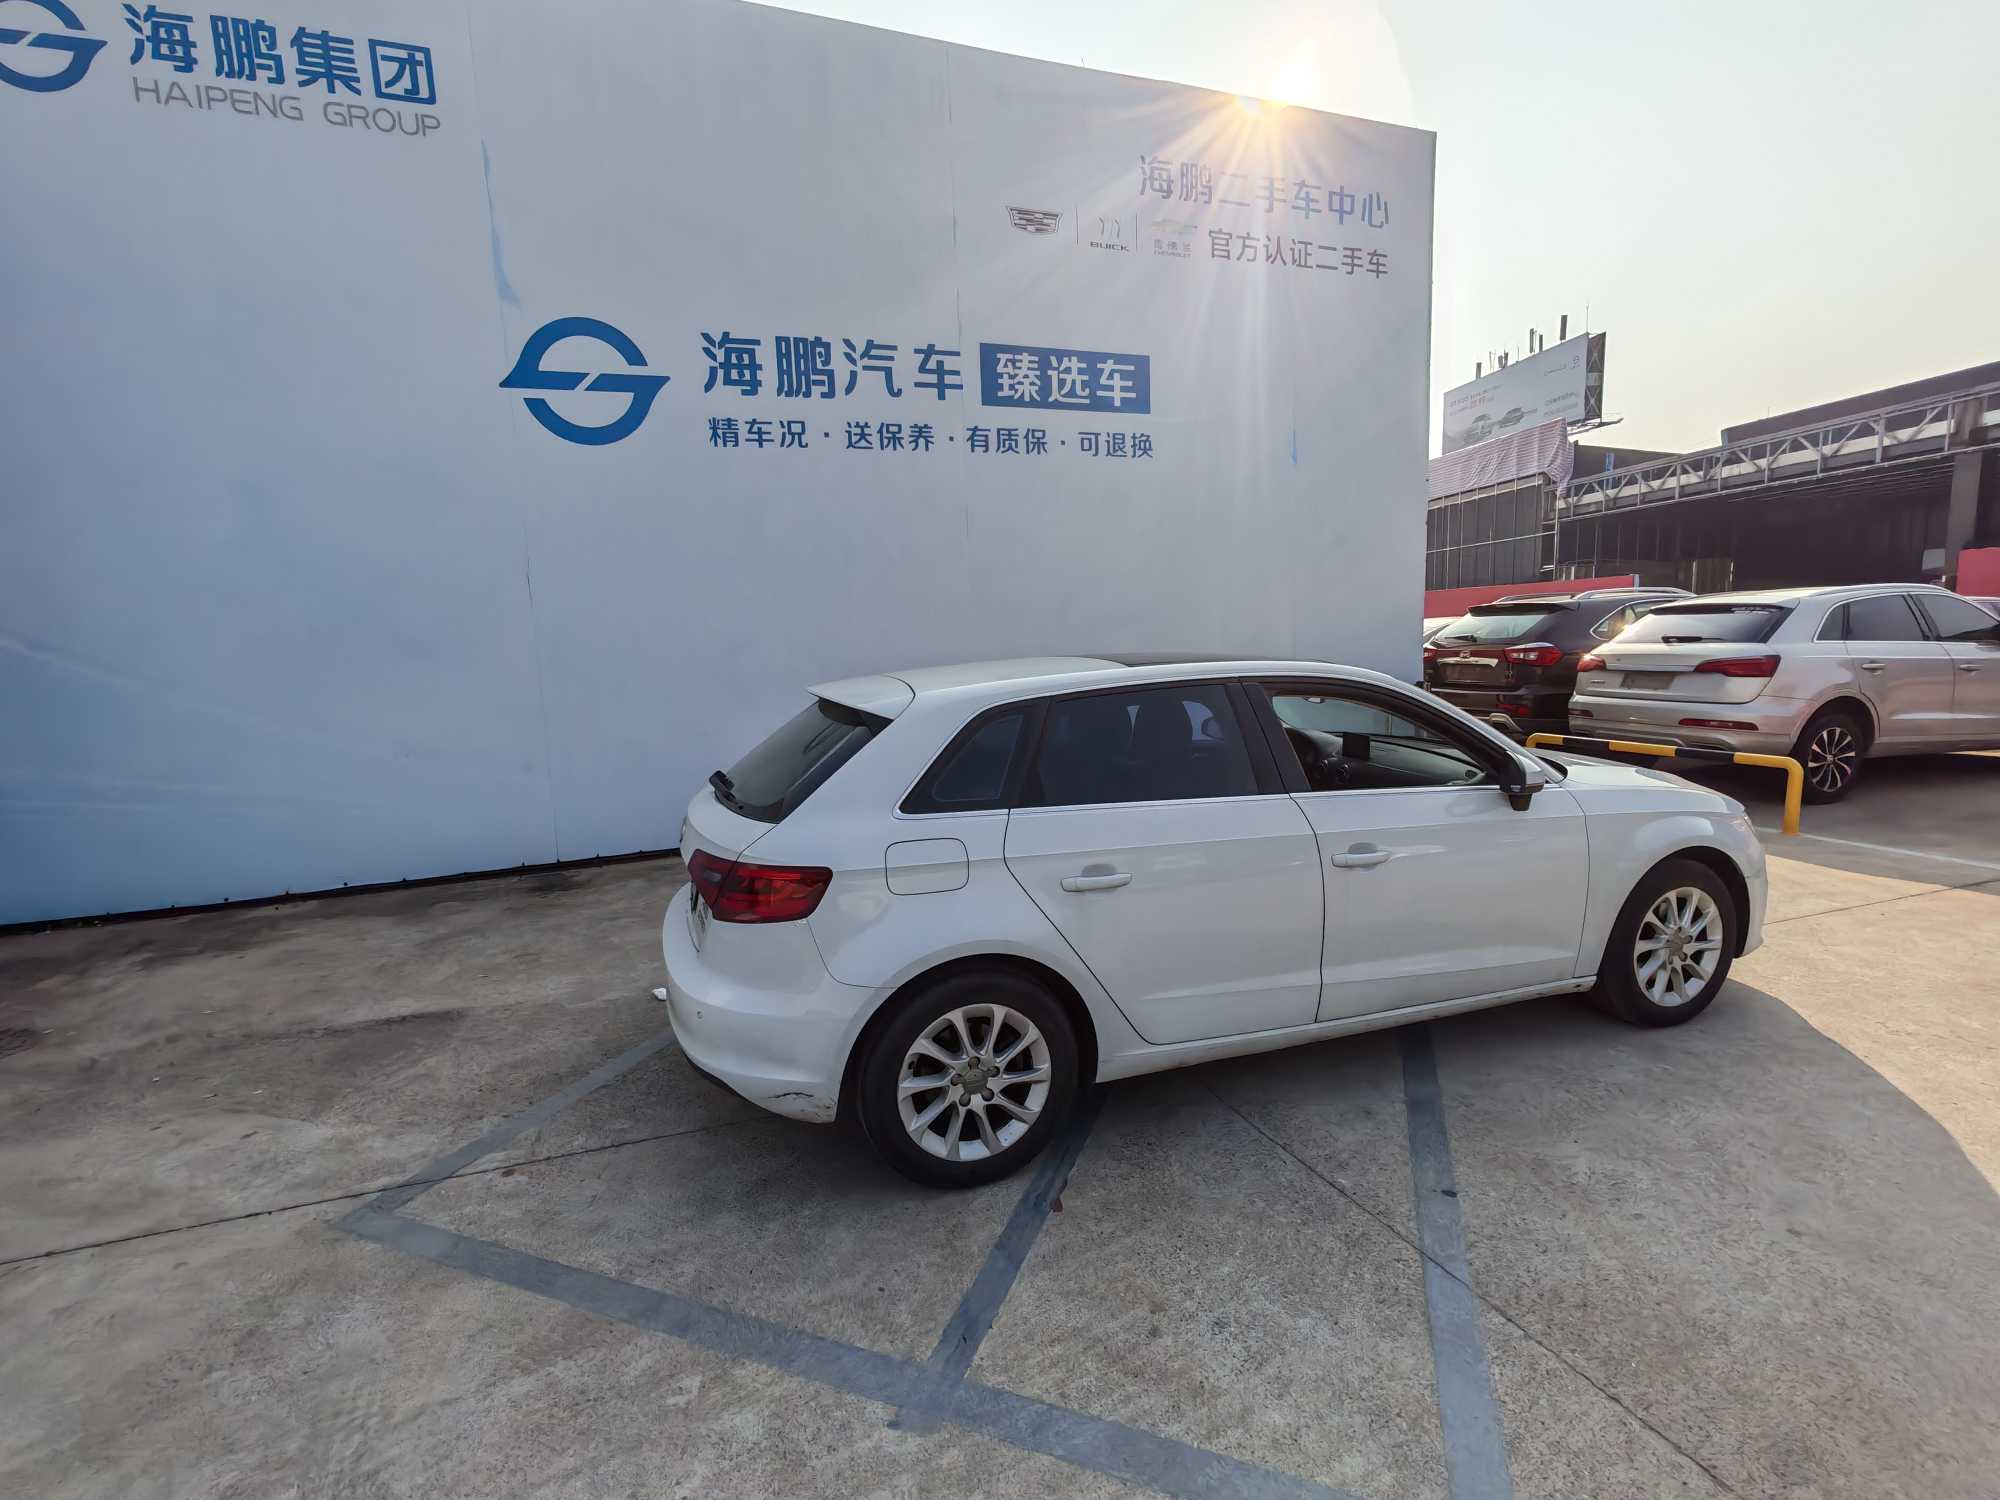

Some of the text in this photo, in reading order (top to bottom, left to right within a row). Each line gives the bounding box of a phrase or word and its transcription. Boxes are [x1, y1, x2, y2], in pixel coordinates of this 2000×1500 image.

[121, 3, 437, 105] 海鹏集团
[132, 77, 441, 137] HAIPENG GROUP
[1139, 155, 1391, 230] 海鹏二手车中心
[1090, 241, 1129, 252] BUICK
[1208, 229, 1390, 280] 官方认证二手车
[700, 332, 1138, 407] 海鹏汽车 臻选车
